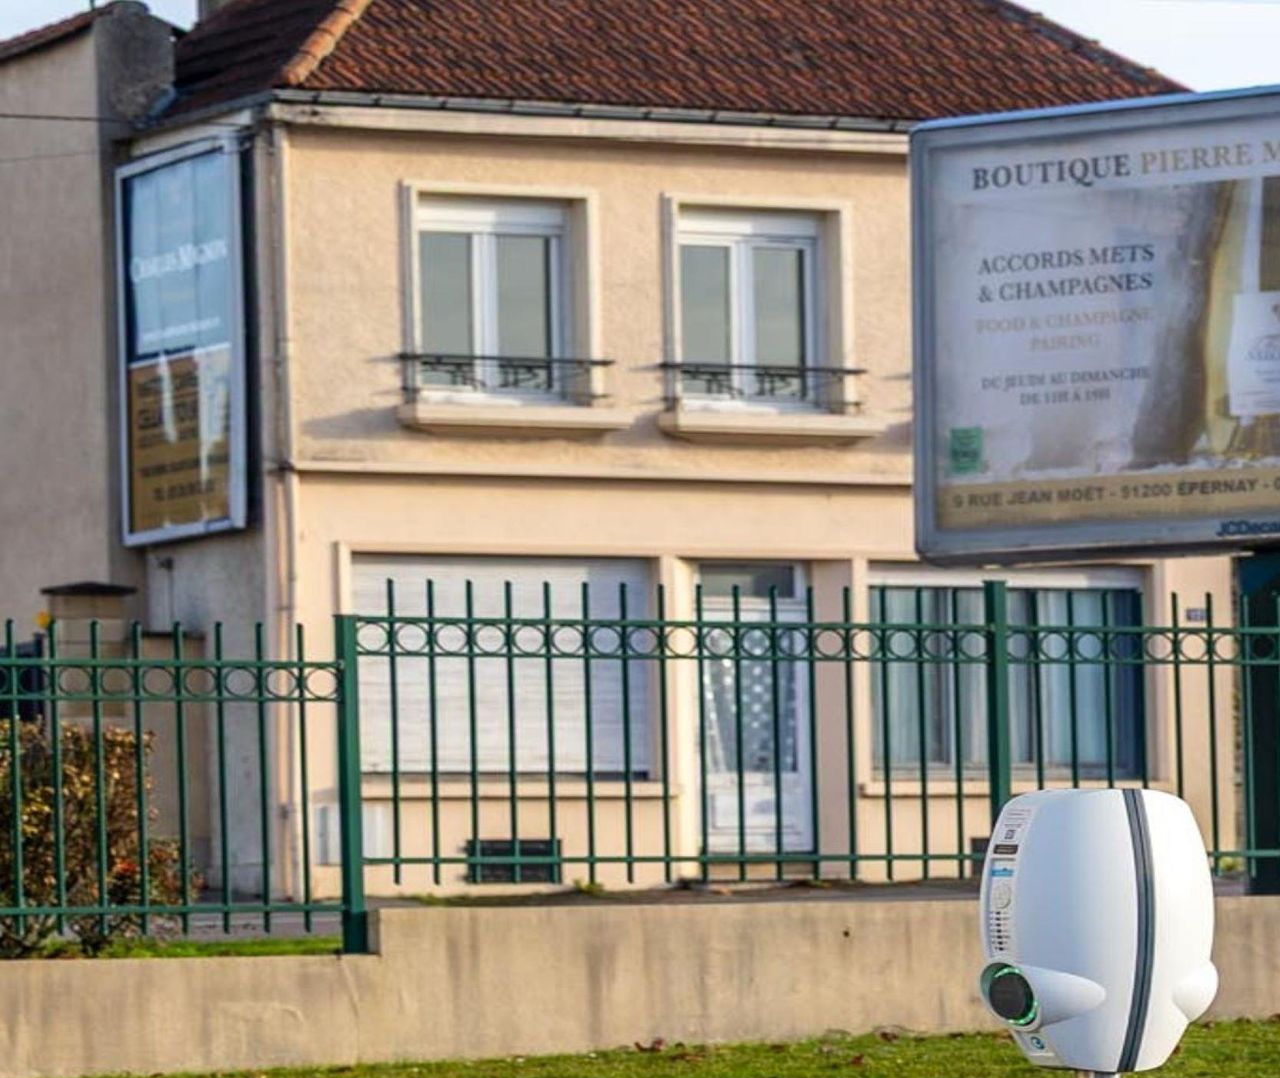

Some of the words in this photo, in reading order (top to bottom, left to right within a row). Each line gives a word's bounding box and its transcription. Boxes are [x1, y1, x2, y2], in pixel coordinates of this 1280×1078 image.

[973, 154, 1131, 190] BOUTIQUE
[1140, 142, 1253, 174] PIERRE
[977, 250, 1085, 275] ACCORDS
[1089, 244, 1155, 266] METS
[977, 285, 993, 303] &
[999, 273, 1153, 301] CHAMPAGNES
[975, 317, 1026, 335] FOOD
[1070, 366, 1151, 385] DIMANCHE
[968, 492, 1003, 507] RUE
[1006, 488, 1052, 505] JEAN
[1121, 482, 1173, 500] 51200
